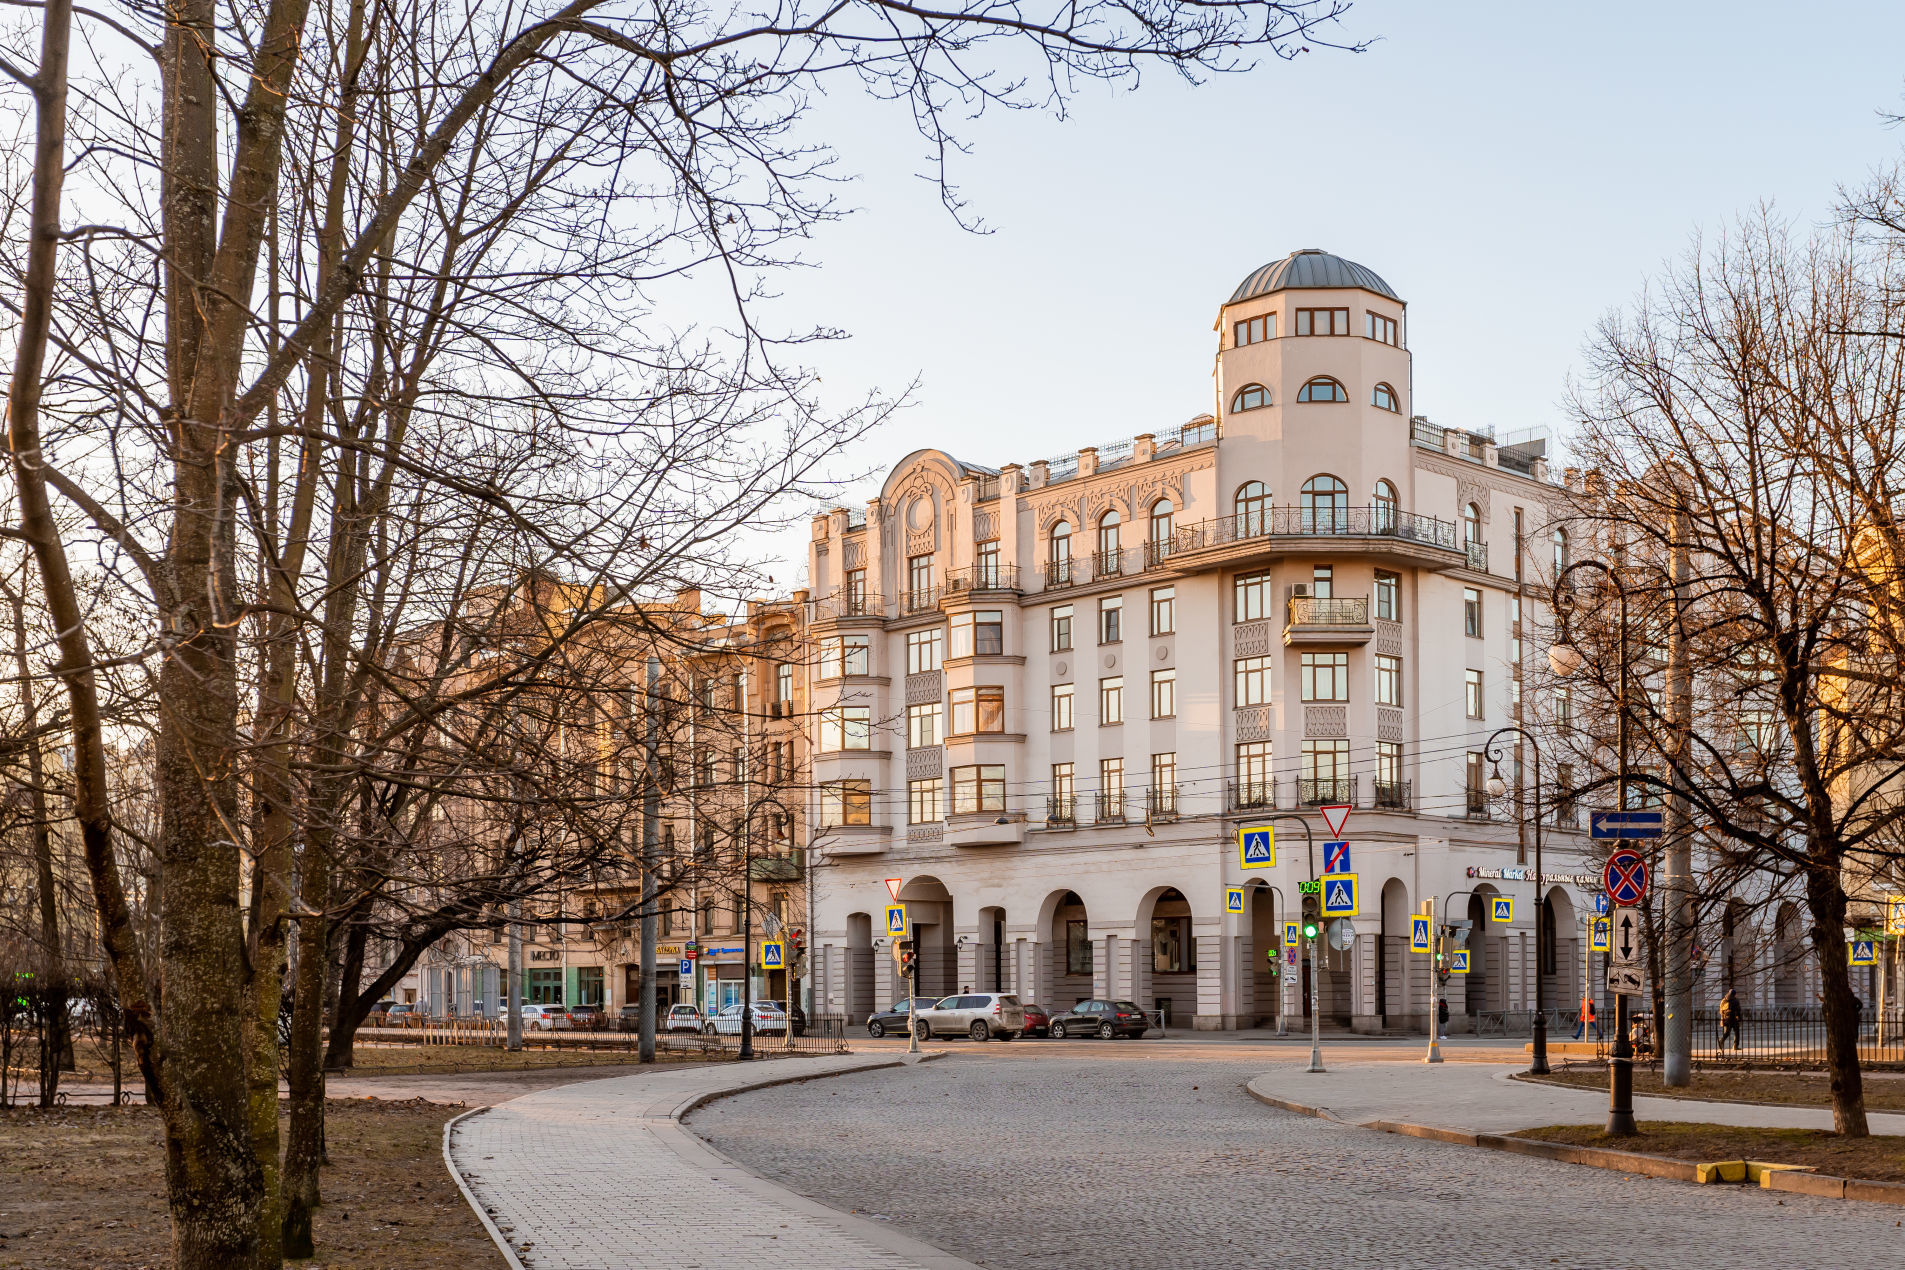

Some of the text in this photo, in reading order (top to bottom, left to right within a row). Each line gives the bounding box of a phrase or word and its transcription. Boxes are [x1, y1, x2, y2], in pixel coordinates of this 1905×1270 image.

[1478, 866, 1524, 880] Mineral Market
[1525, 868, 1574, 885] Науральные
[682, 961, 690, 973] P
